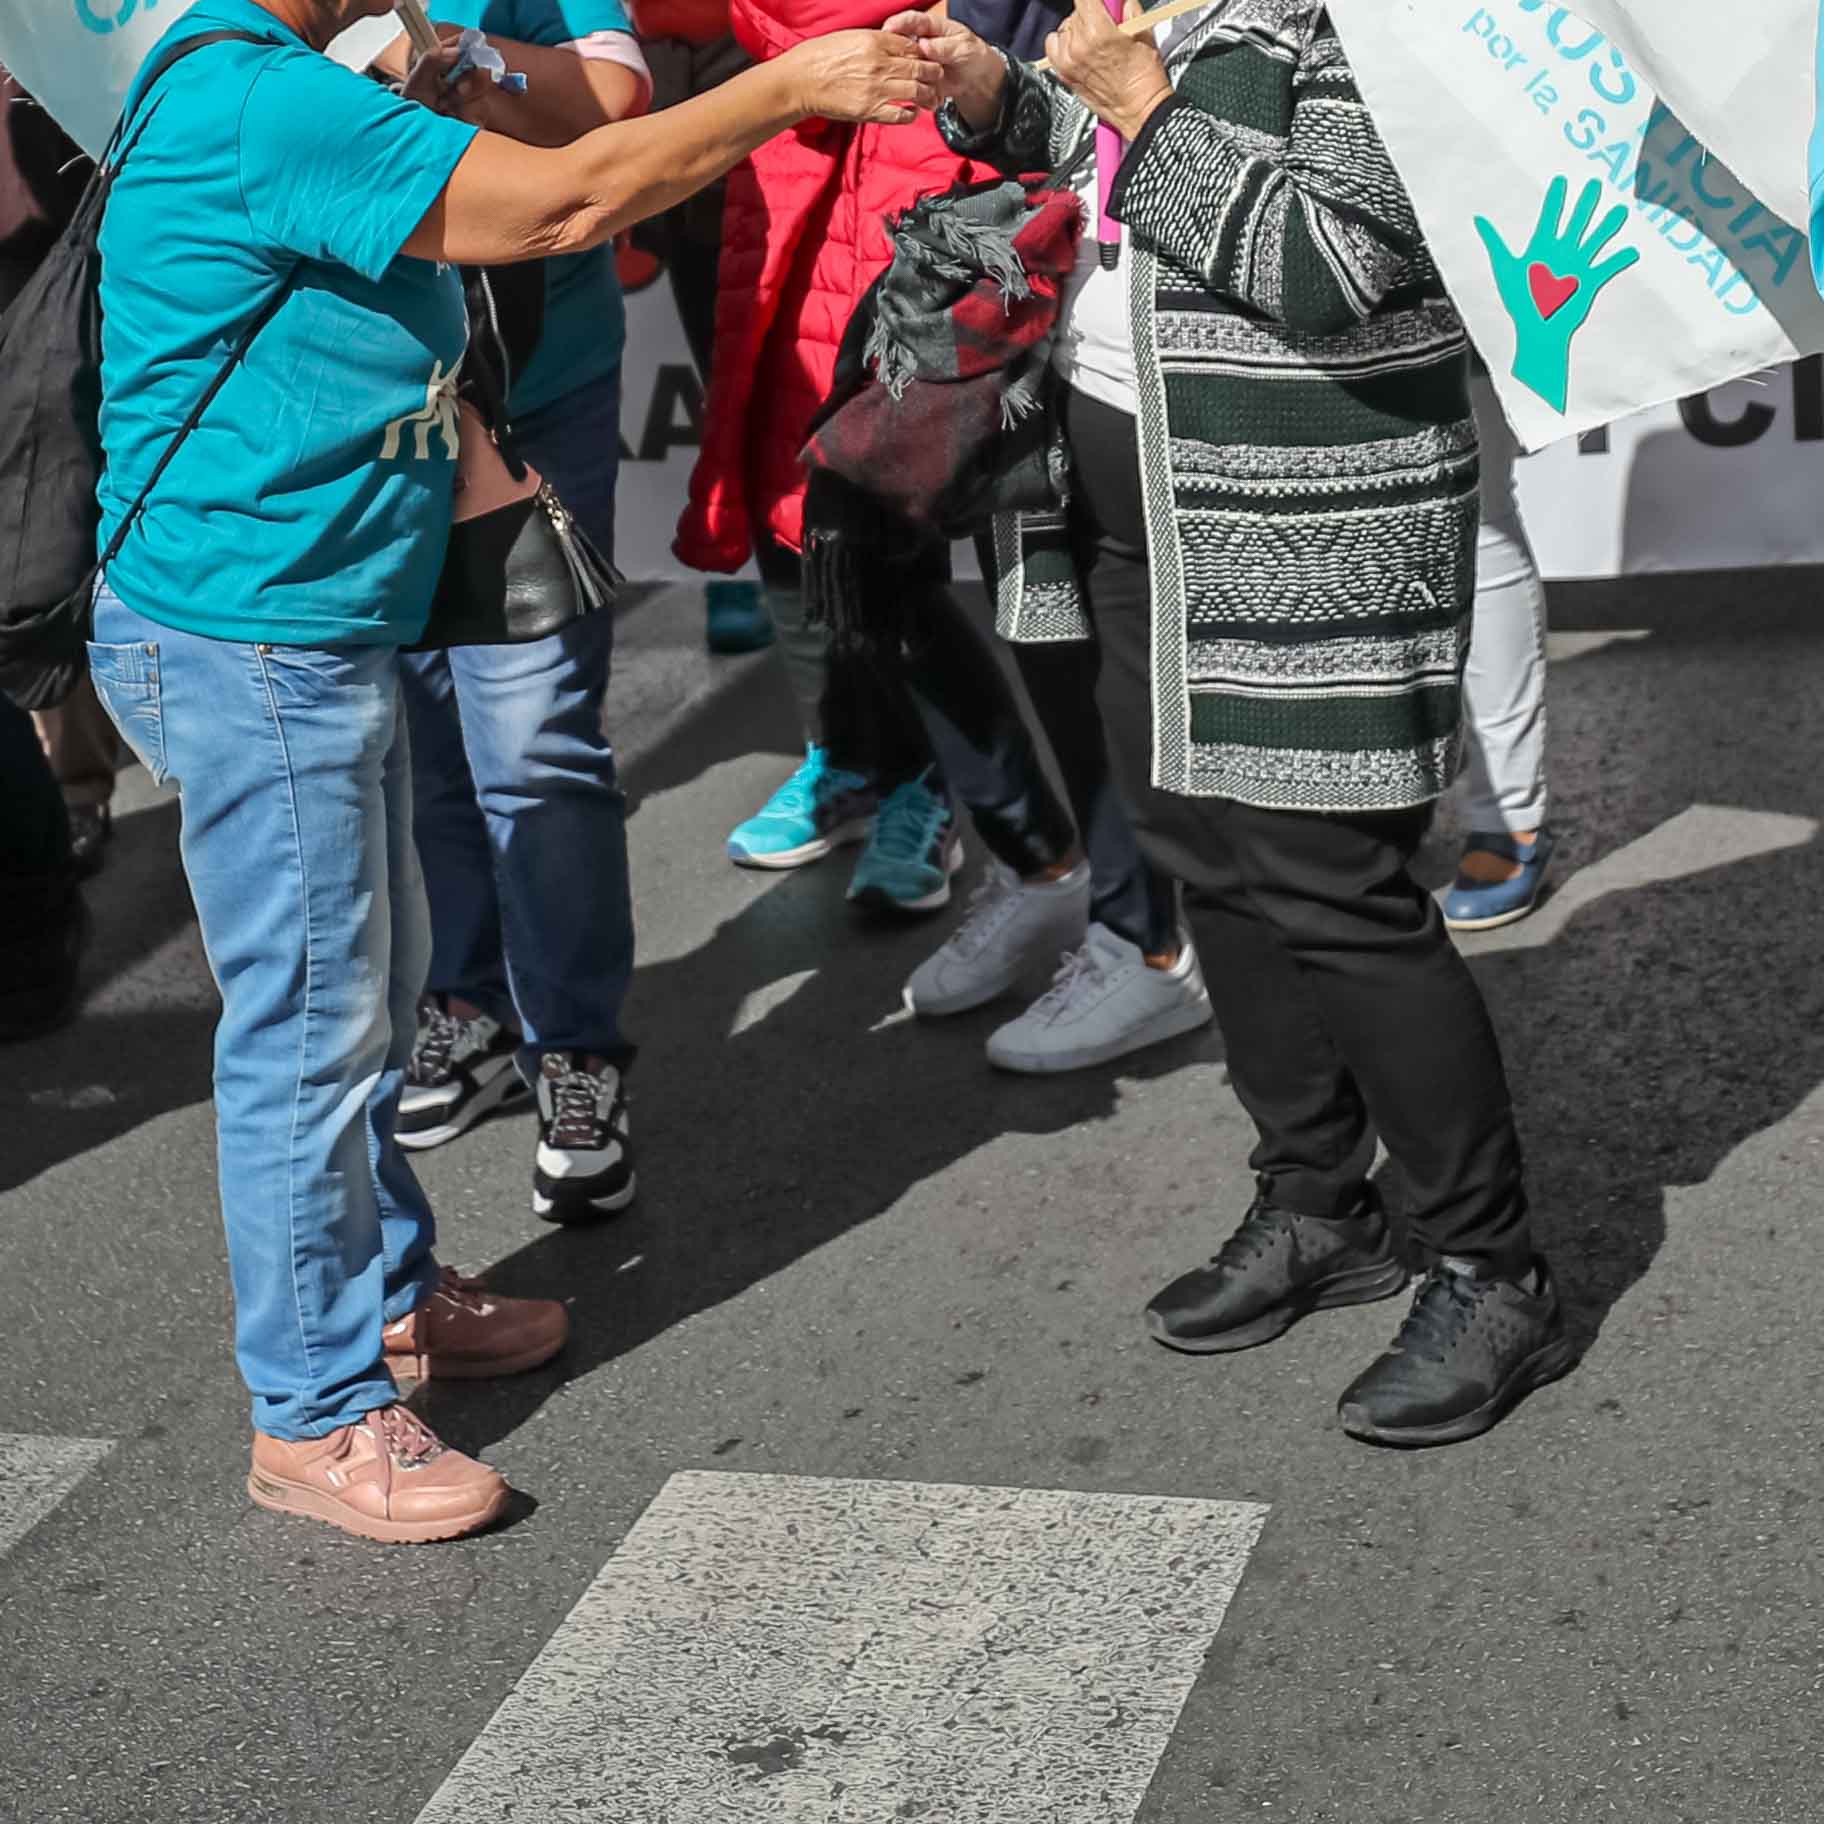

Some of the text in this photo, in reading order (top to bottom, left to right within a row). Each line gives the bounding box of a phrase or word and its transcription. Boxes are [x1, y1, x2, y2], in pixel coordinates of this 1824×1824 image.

[1462, 8, 1762, 315] por la SANIDAD
